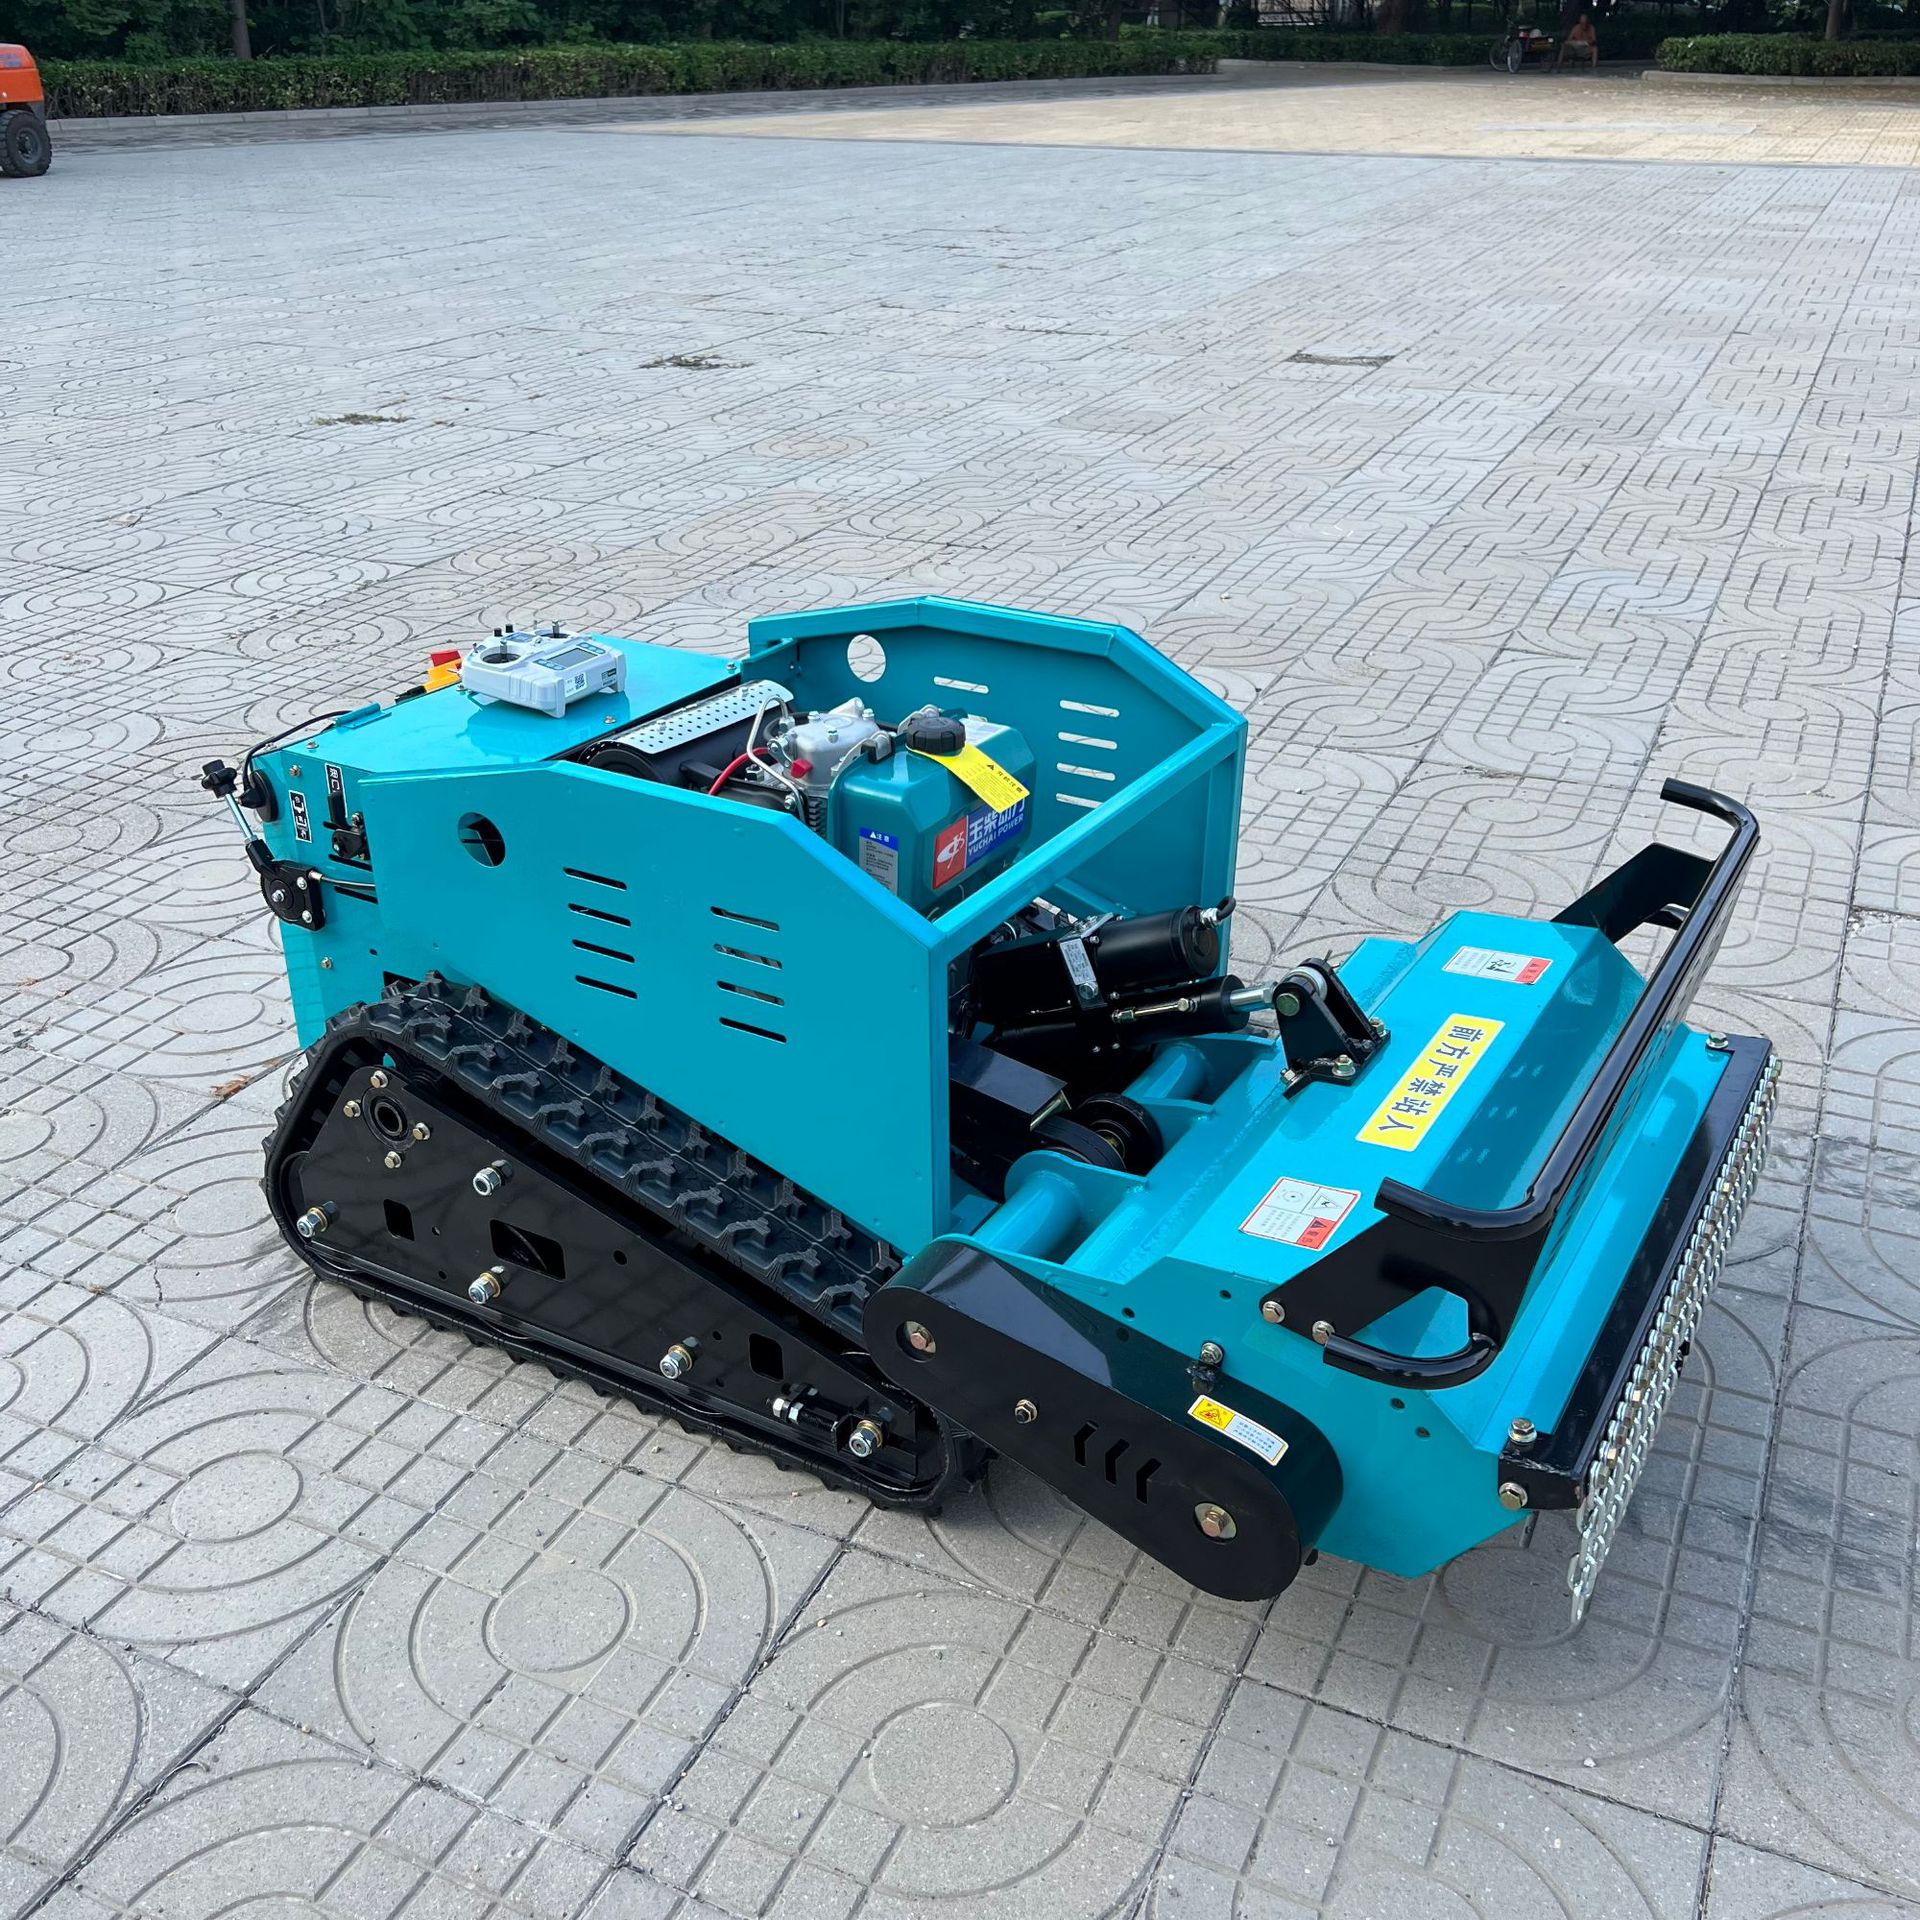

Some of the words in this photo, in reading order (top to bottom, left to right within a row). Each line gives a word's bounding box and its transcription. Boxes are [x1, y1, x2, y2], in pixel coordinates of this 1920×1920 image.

[968, 832, 997, 856] YUCHAI
[997, 813, 1024, 836] POWER
[1377, 1025, 1484, 1131] 前方严禁站人
